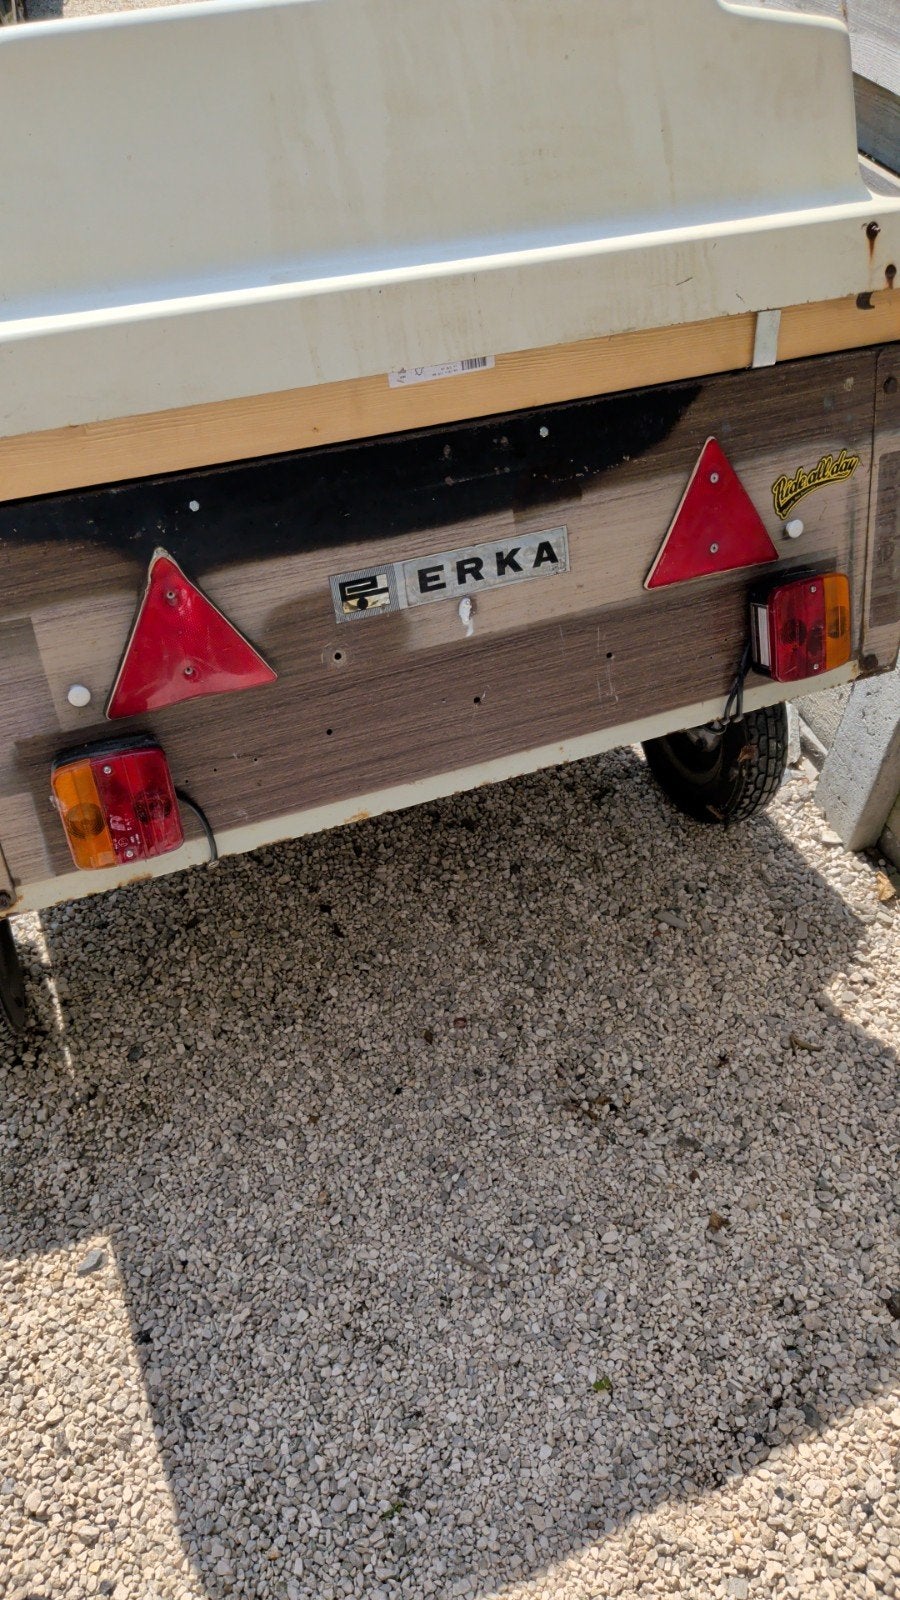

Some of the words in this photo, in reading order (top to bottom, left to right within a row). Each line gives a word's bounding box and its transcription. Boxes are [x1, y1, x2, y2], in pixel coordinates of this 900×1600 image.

[808, 455, 833, 485] all
[830, 450, 859, 478] day
[418, 540, 559, 594] ERKA
